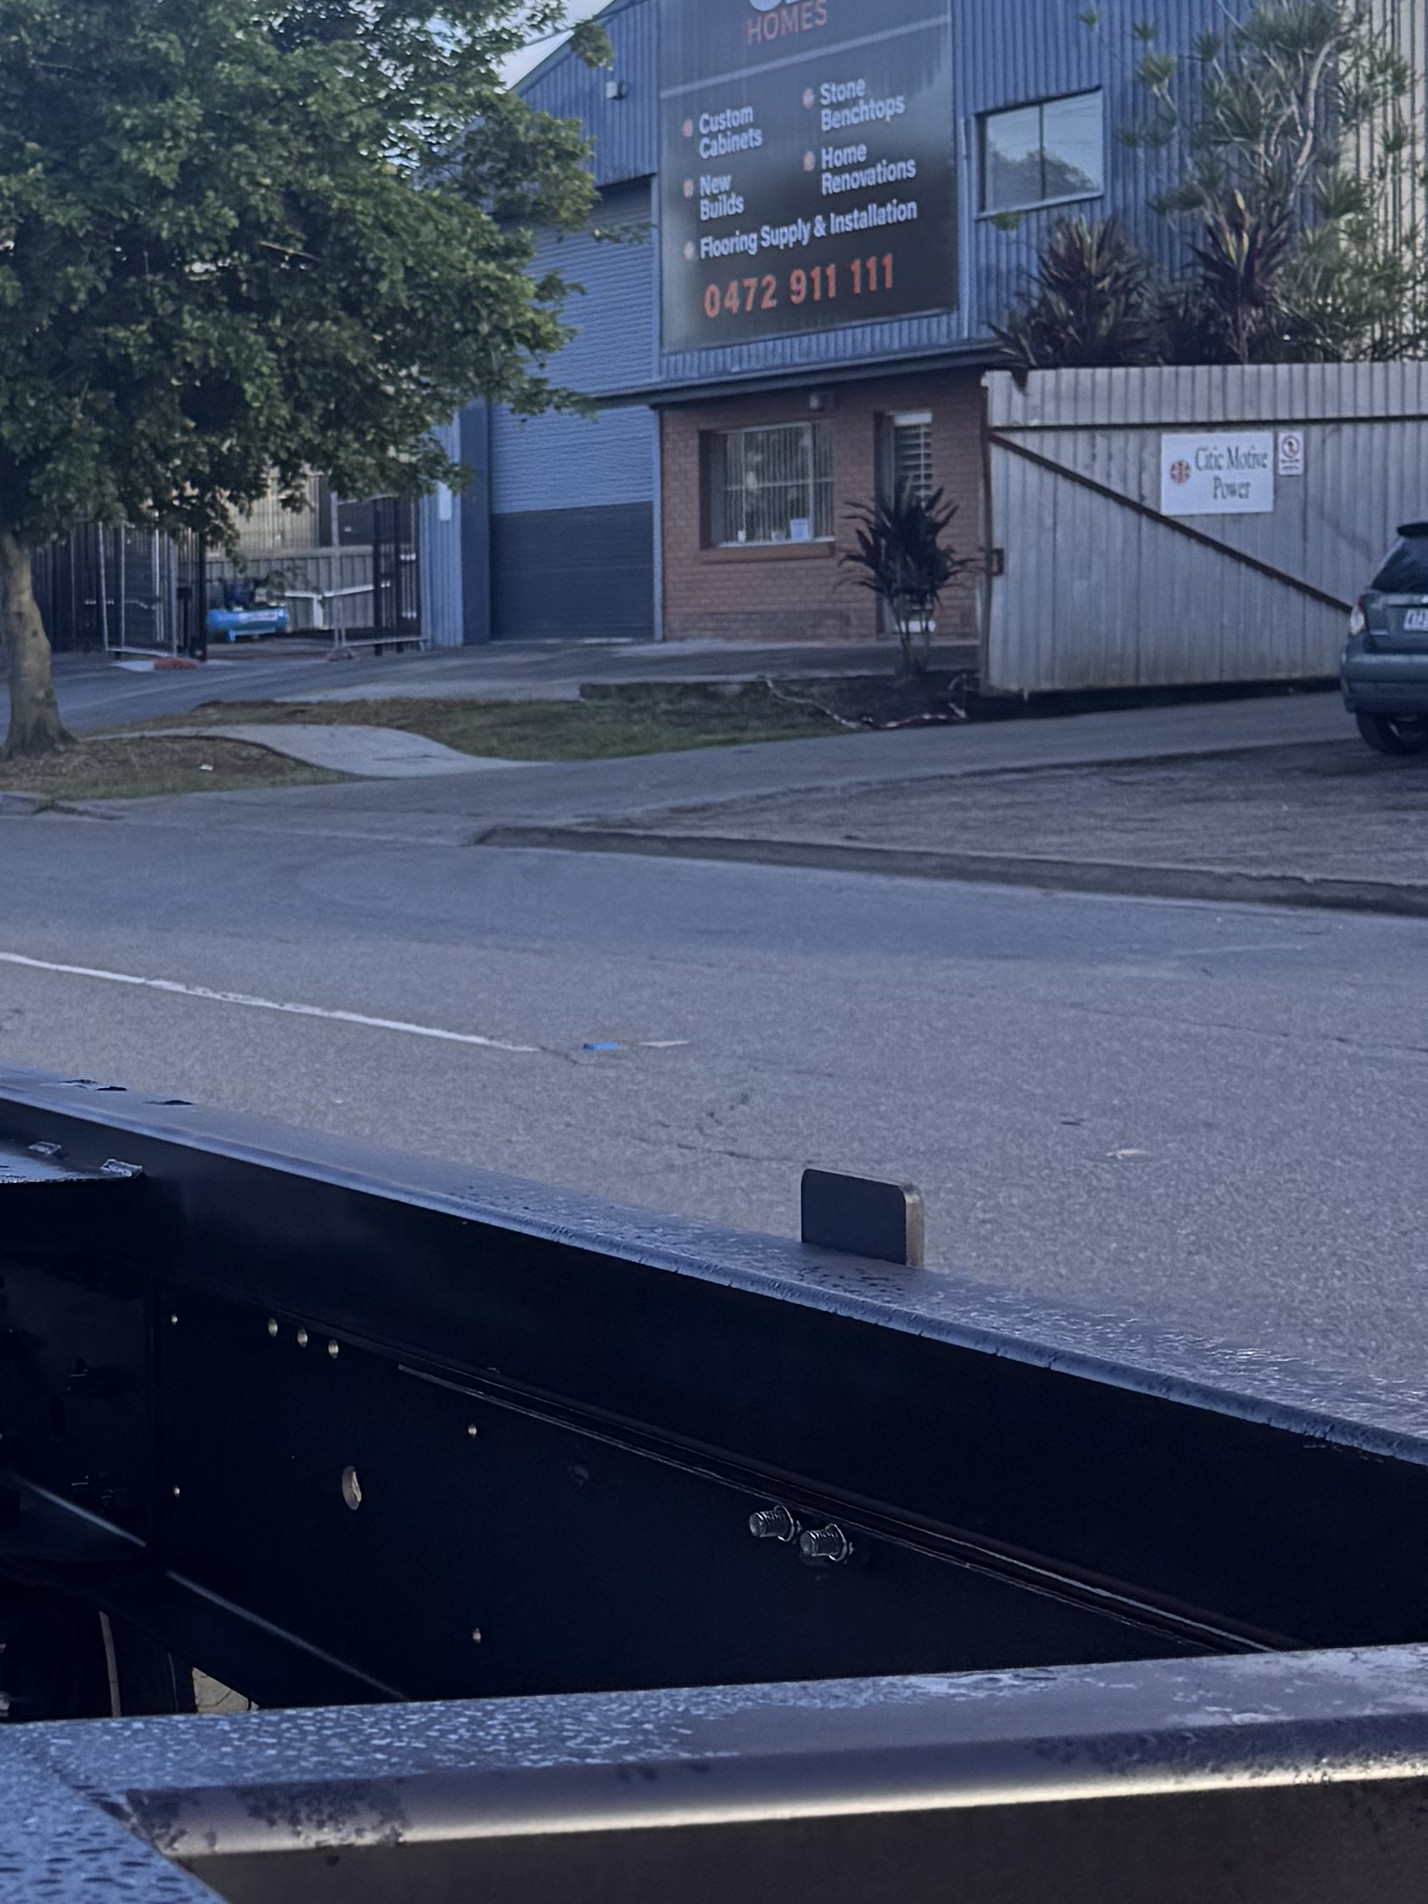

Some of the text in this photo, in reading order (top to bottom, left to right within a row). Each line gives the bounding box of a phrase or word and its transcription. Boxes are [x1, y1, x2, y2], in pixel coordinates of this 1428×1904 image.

[820, 79, 866, 106] Stone
[699, 106, 754, 134] Custom
[821, 95, 906, 132] Benchtops
[699, 128, 763, 159] Cabinets
[821, 143, 867, 170] Home
[700, 175, 732, 197] New
[822, 159, 917, 196] Renovations
[700, 193, 744, 221] Builds
[700, 198, 918, 259] Flooring Supply & Installation
[703, 253, 893, 318] 0472 911 111
[1226, 445, 1268, 470] Motive
[1213, 476, 1251, 500] Power
